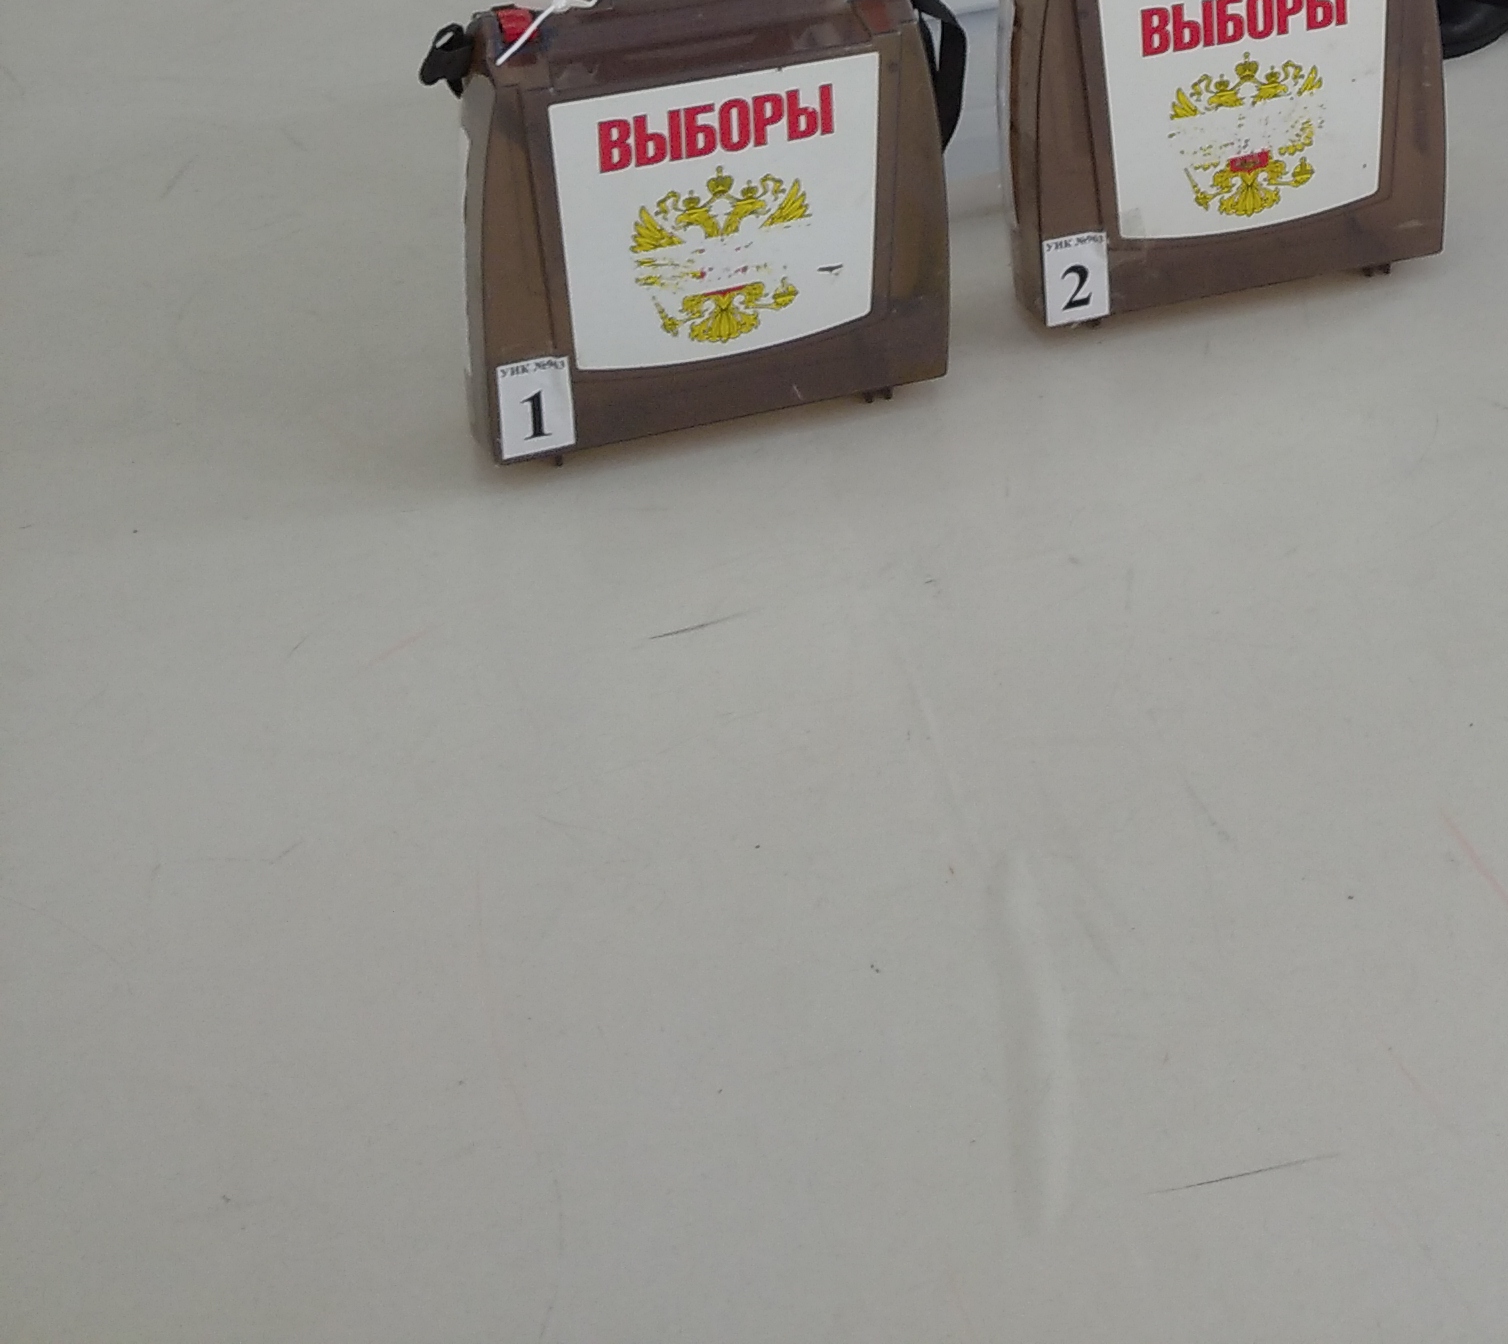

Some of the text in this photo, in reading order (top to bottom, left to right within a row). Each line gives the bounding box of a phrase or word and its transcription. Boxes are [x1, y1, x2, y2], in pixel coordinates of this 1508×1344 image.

[597, 82, 834, 174] ВЫБОРЫ
[1061, 264, 1093, 311] 2
[520, 389, 552, 441] 1
